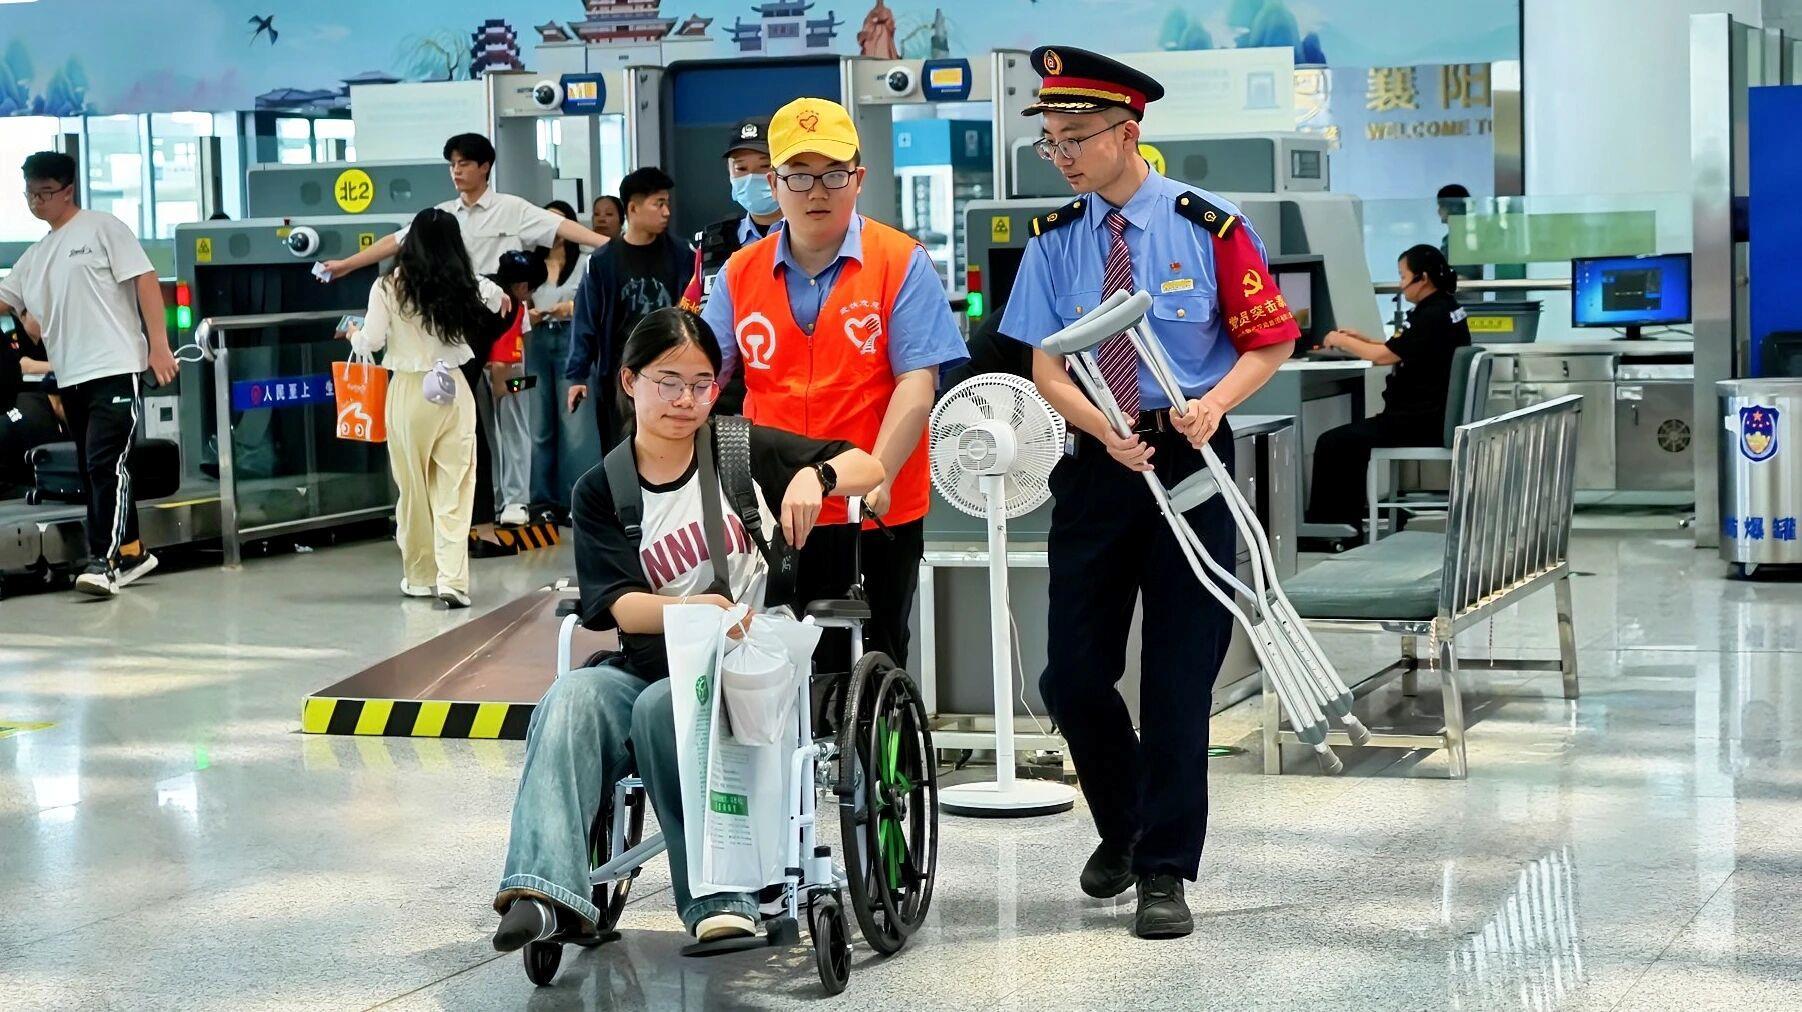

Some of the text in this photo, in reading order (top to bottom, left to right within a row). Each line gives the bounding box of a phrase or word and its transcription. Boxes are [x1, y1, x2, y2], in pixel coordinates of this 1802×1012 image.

[1366, 118, 1492, 140] WELCOME T
[340, 181, 370, 201] 北2
[263, 382, 311, 402] 人民至上
